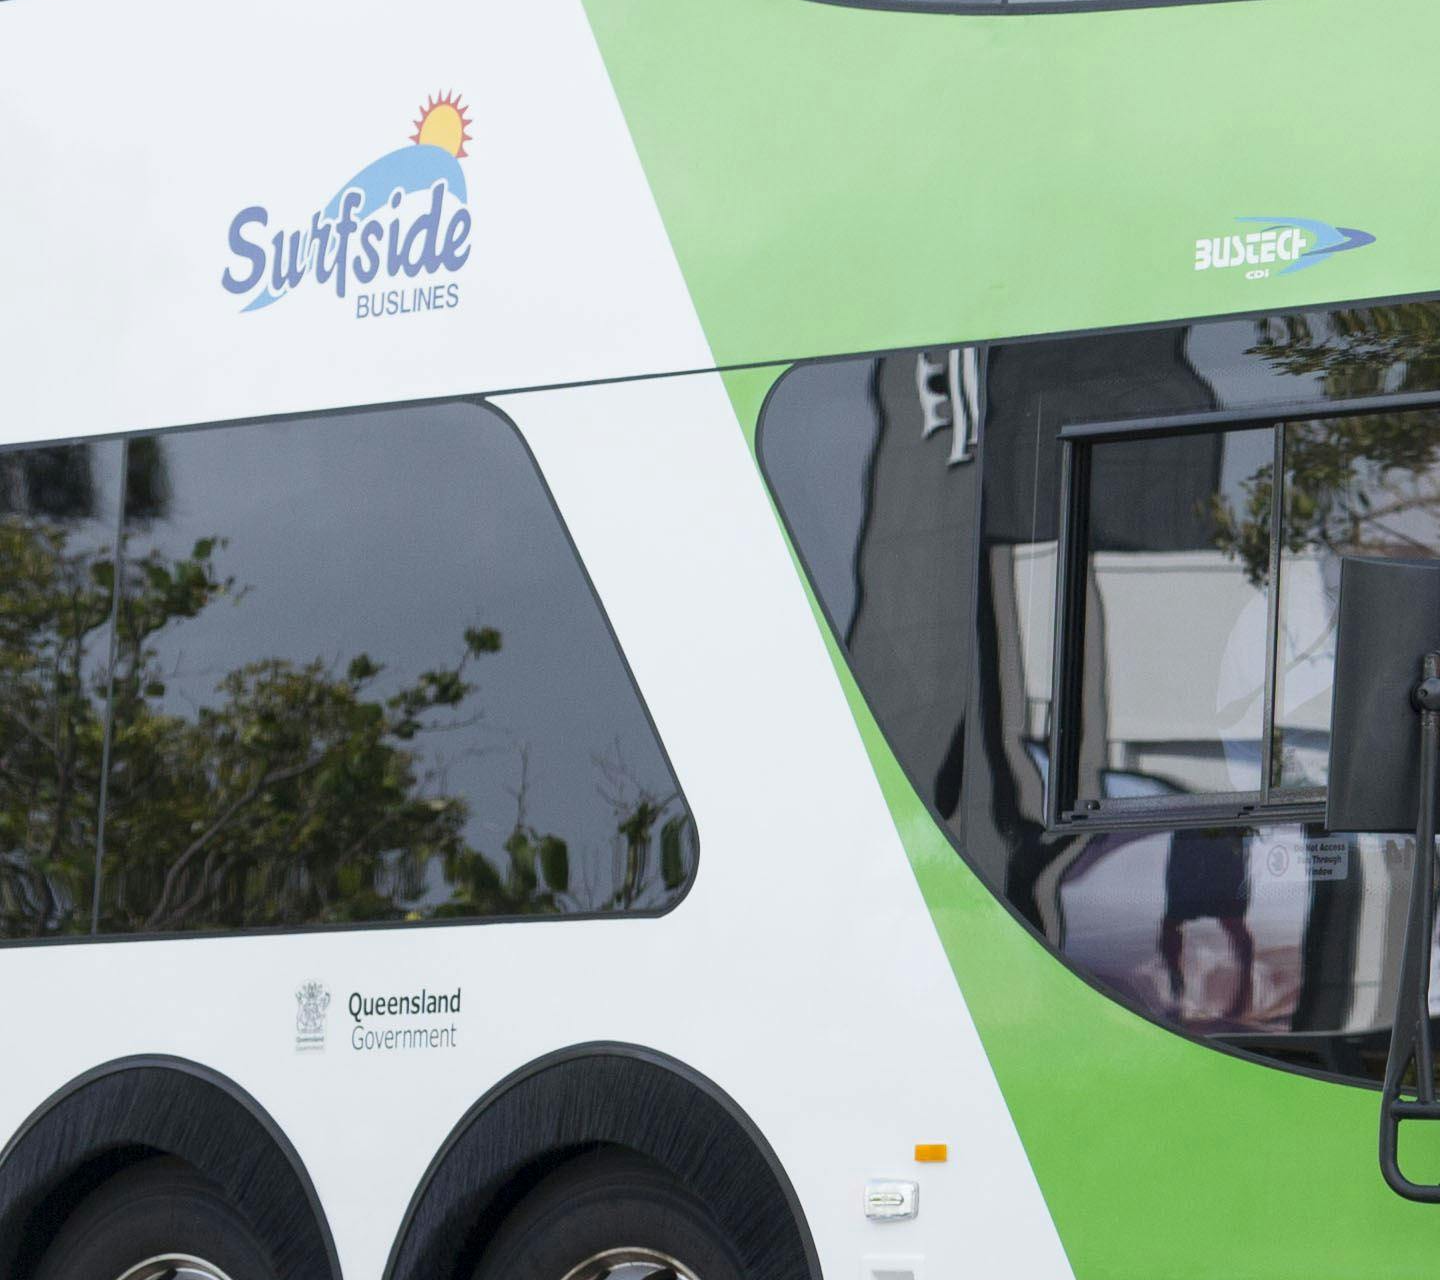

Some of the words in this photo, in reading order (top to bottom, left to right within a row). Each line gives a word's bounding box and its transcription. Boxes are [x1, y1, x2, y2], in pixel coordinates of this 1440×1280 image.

[221, 182, 472, 299] Surfside
[1194, 228, 1307, 271] BUSTECH
[356, 283, 460, 319] BUSLINES
[348, 987, 462, 1023] Queensland
[351, 1023, 457, 1051] Government
